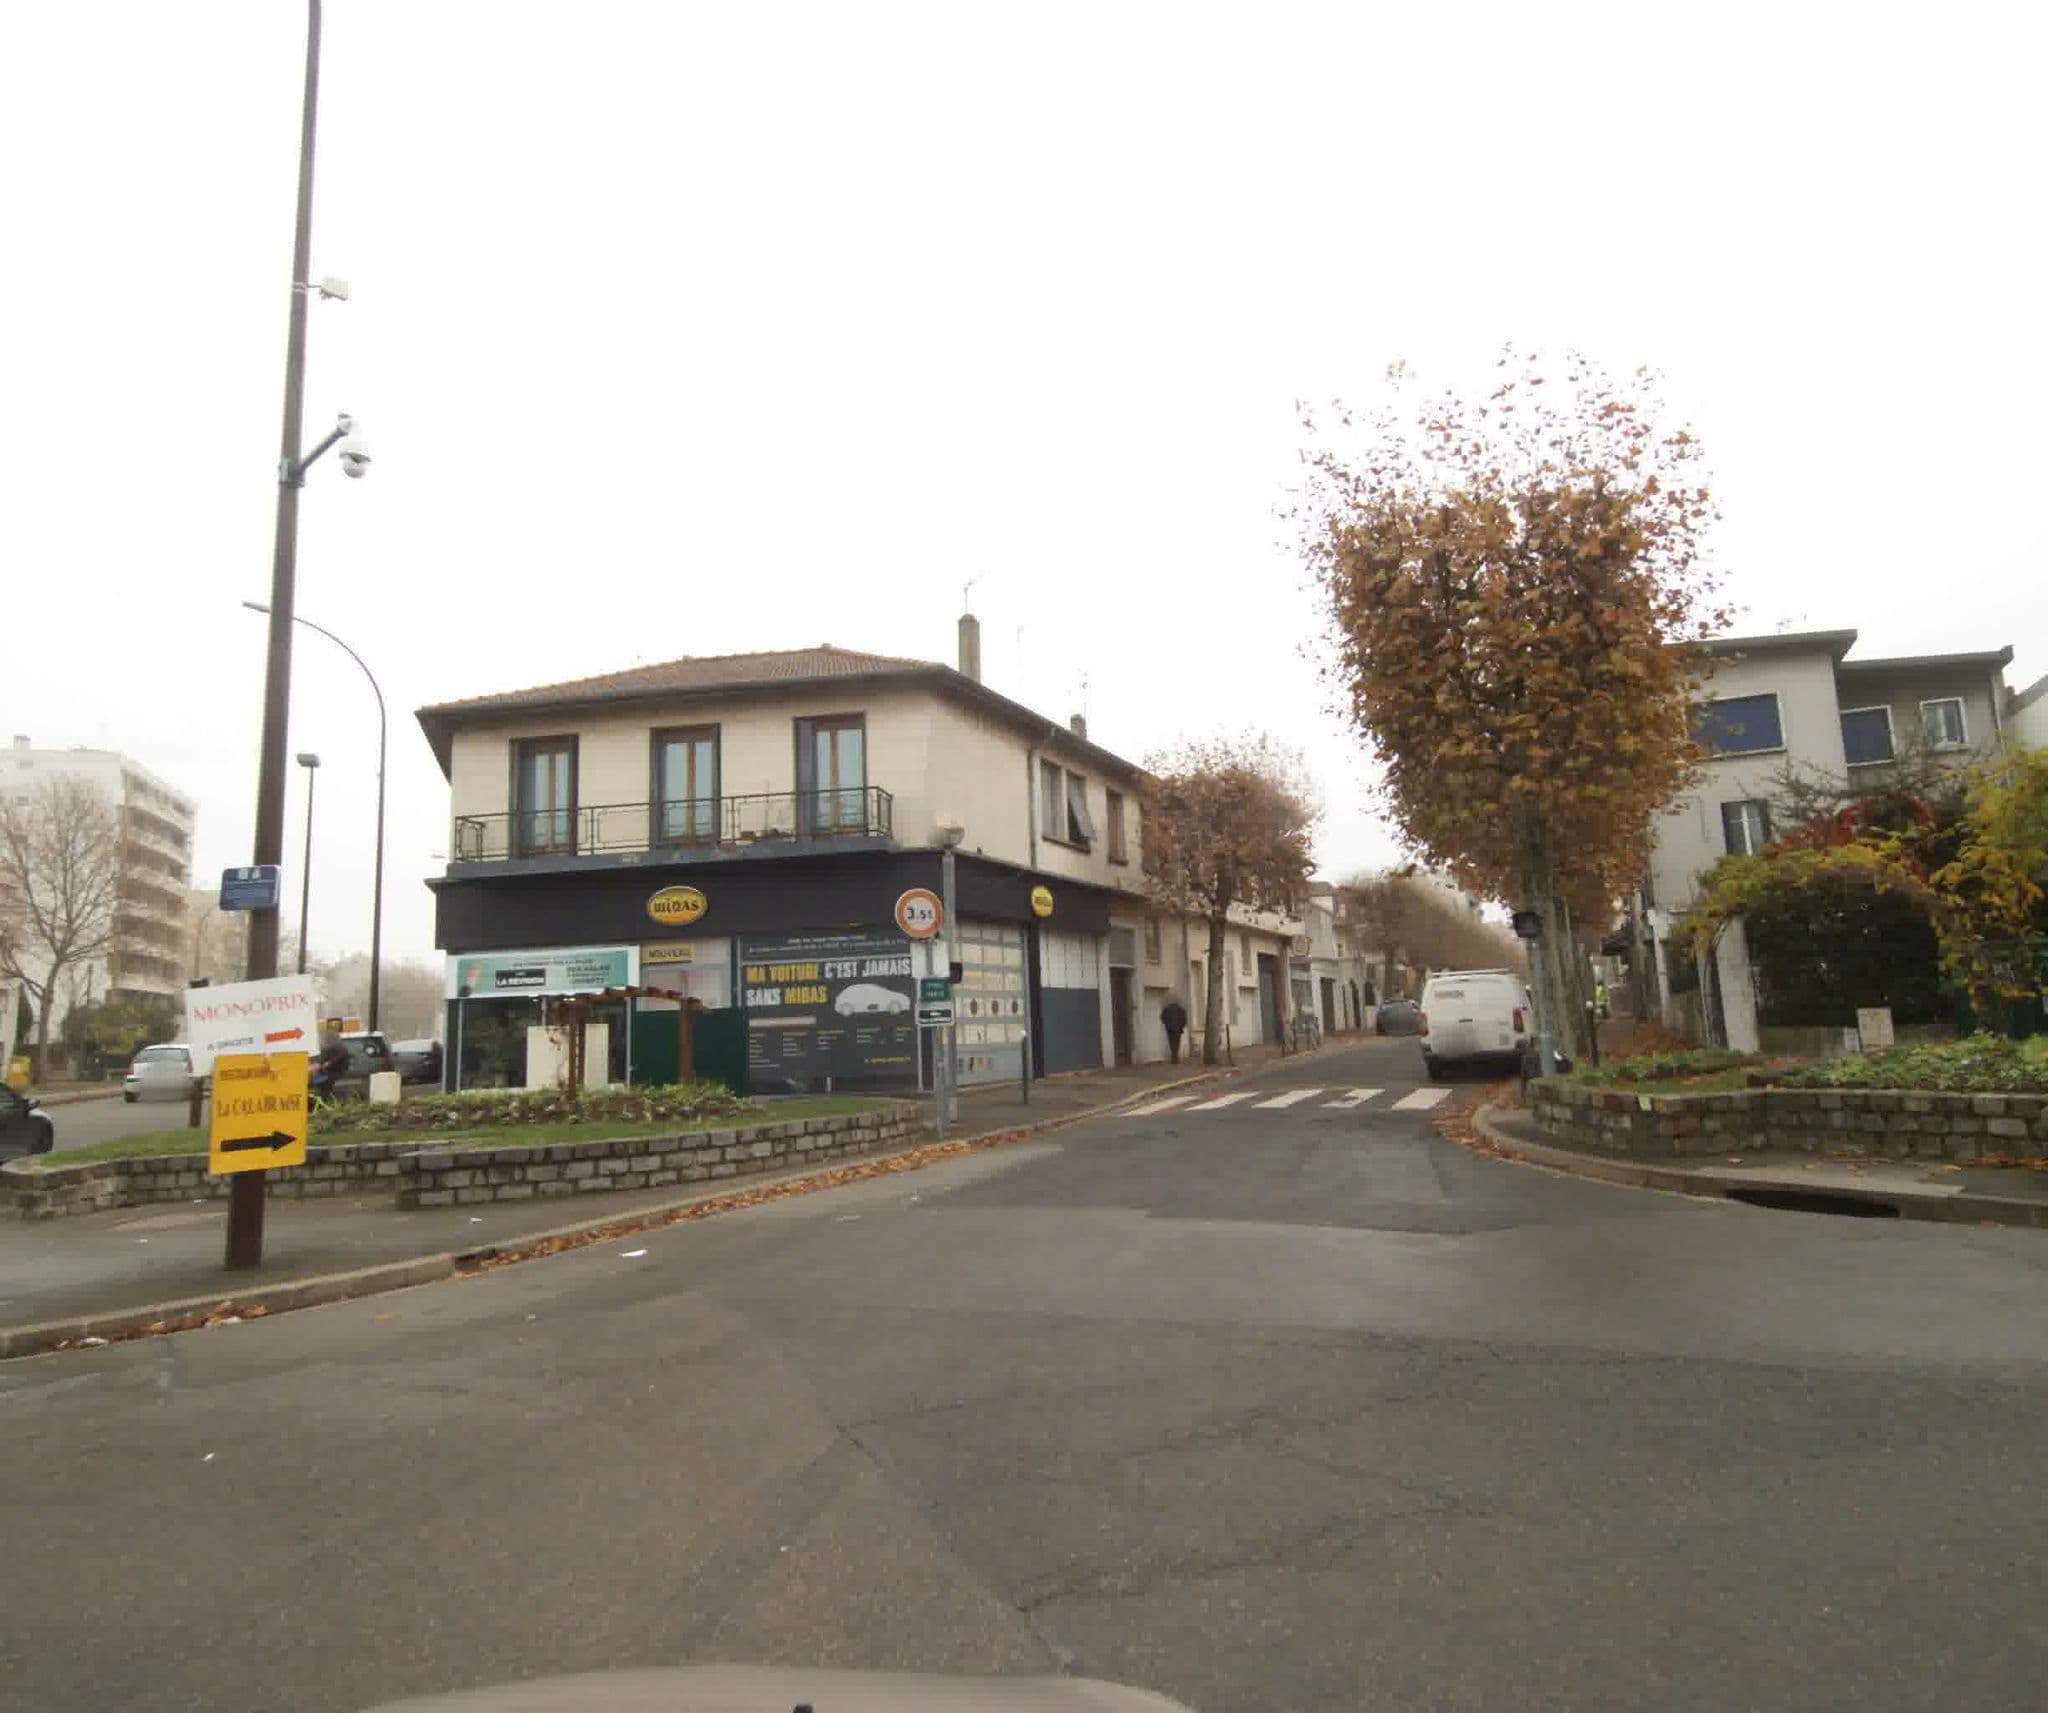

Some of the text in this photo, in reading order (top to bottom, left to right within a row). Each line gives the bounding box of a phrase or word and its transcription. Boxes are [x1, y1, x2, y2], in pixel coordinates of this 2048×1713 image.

[746, 966, 766, 983] MA
[824, 961, 859, 979] C'EST
[862, 956, 912, 978] JAMAIS
[193, 992, 310, 1023] MONOPRIX
[746, 985, 828, 1007] SANS MIDAS
